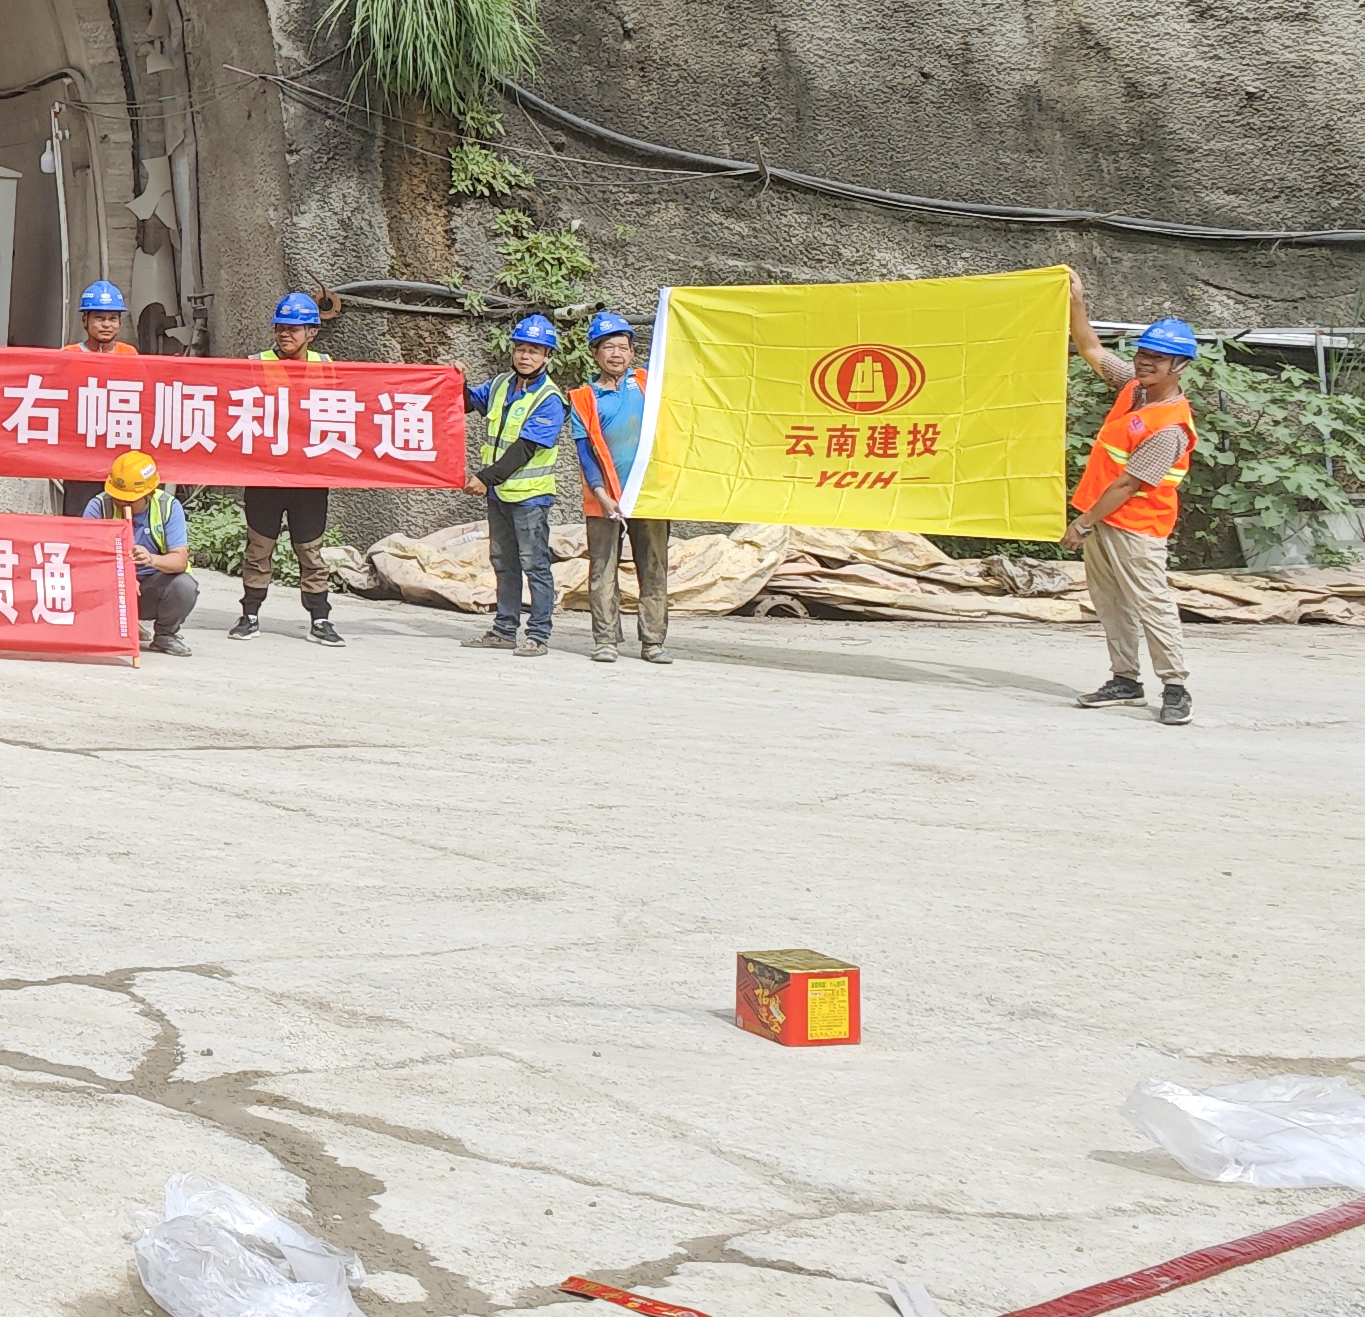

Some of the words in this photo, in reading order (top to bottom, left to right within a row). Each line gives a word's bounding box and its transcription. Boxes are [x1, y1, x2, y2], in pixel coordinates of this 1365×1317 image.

[785, 422, 942, 459] 云南建投
[814, 470, 898, 489] YCIH
